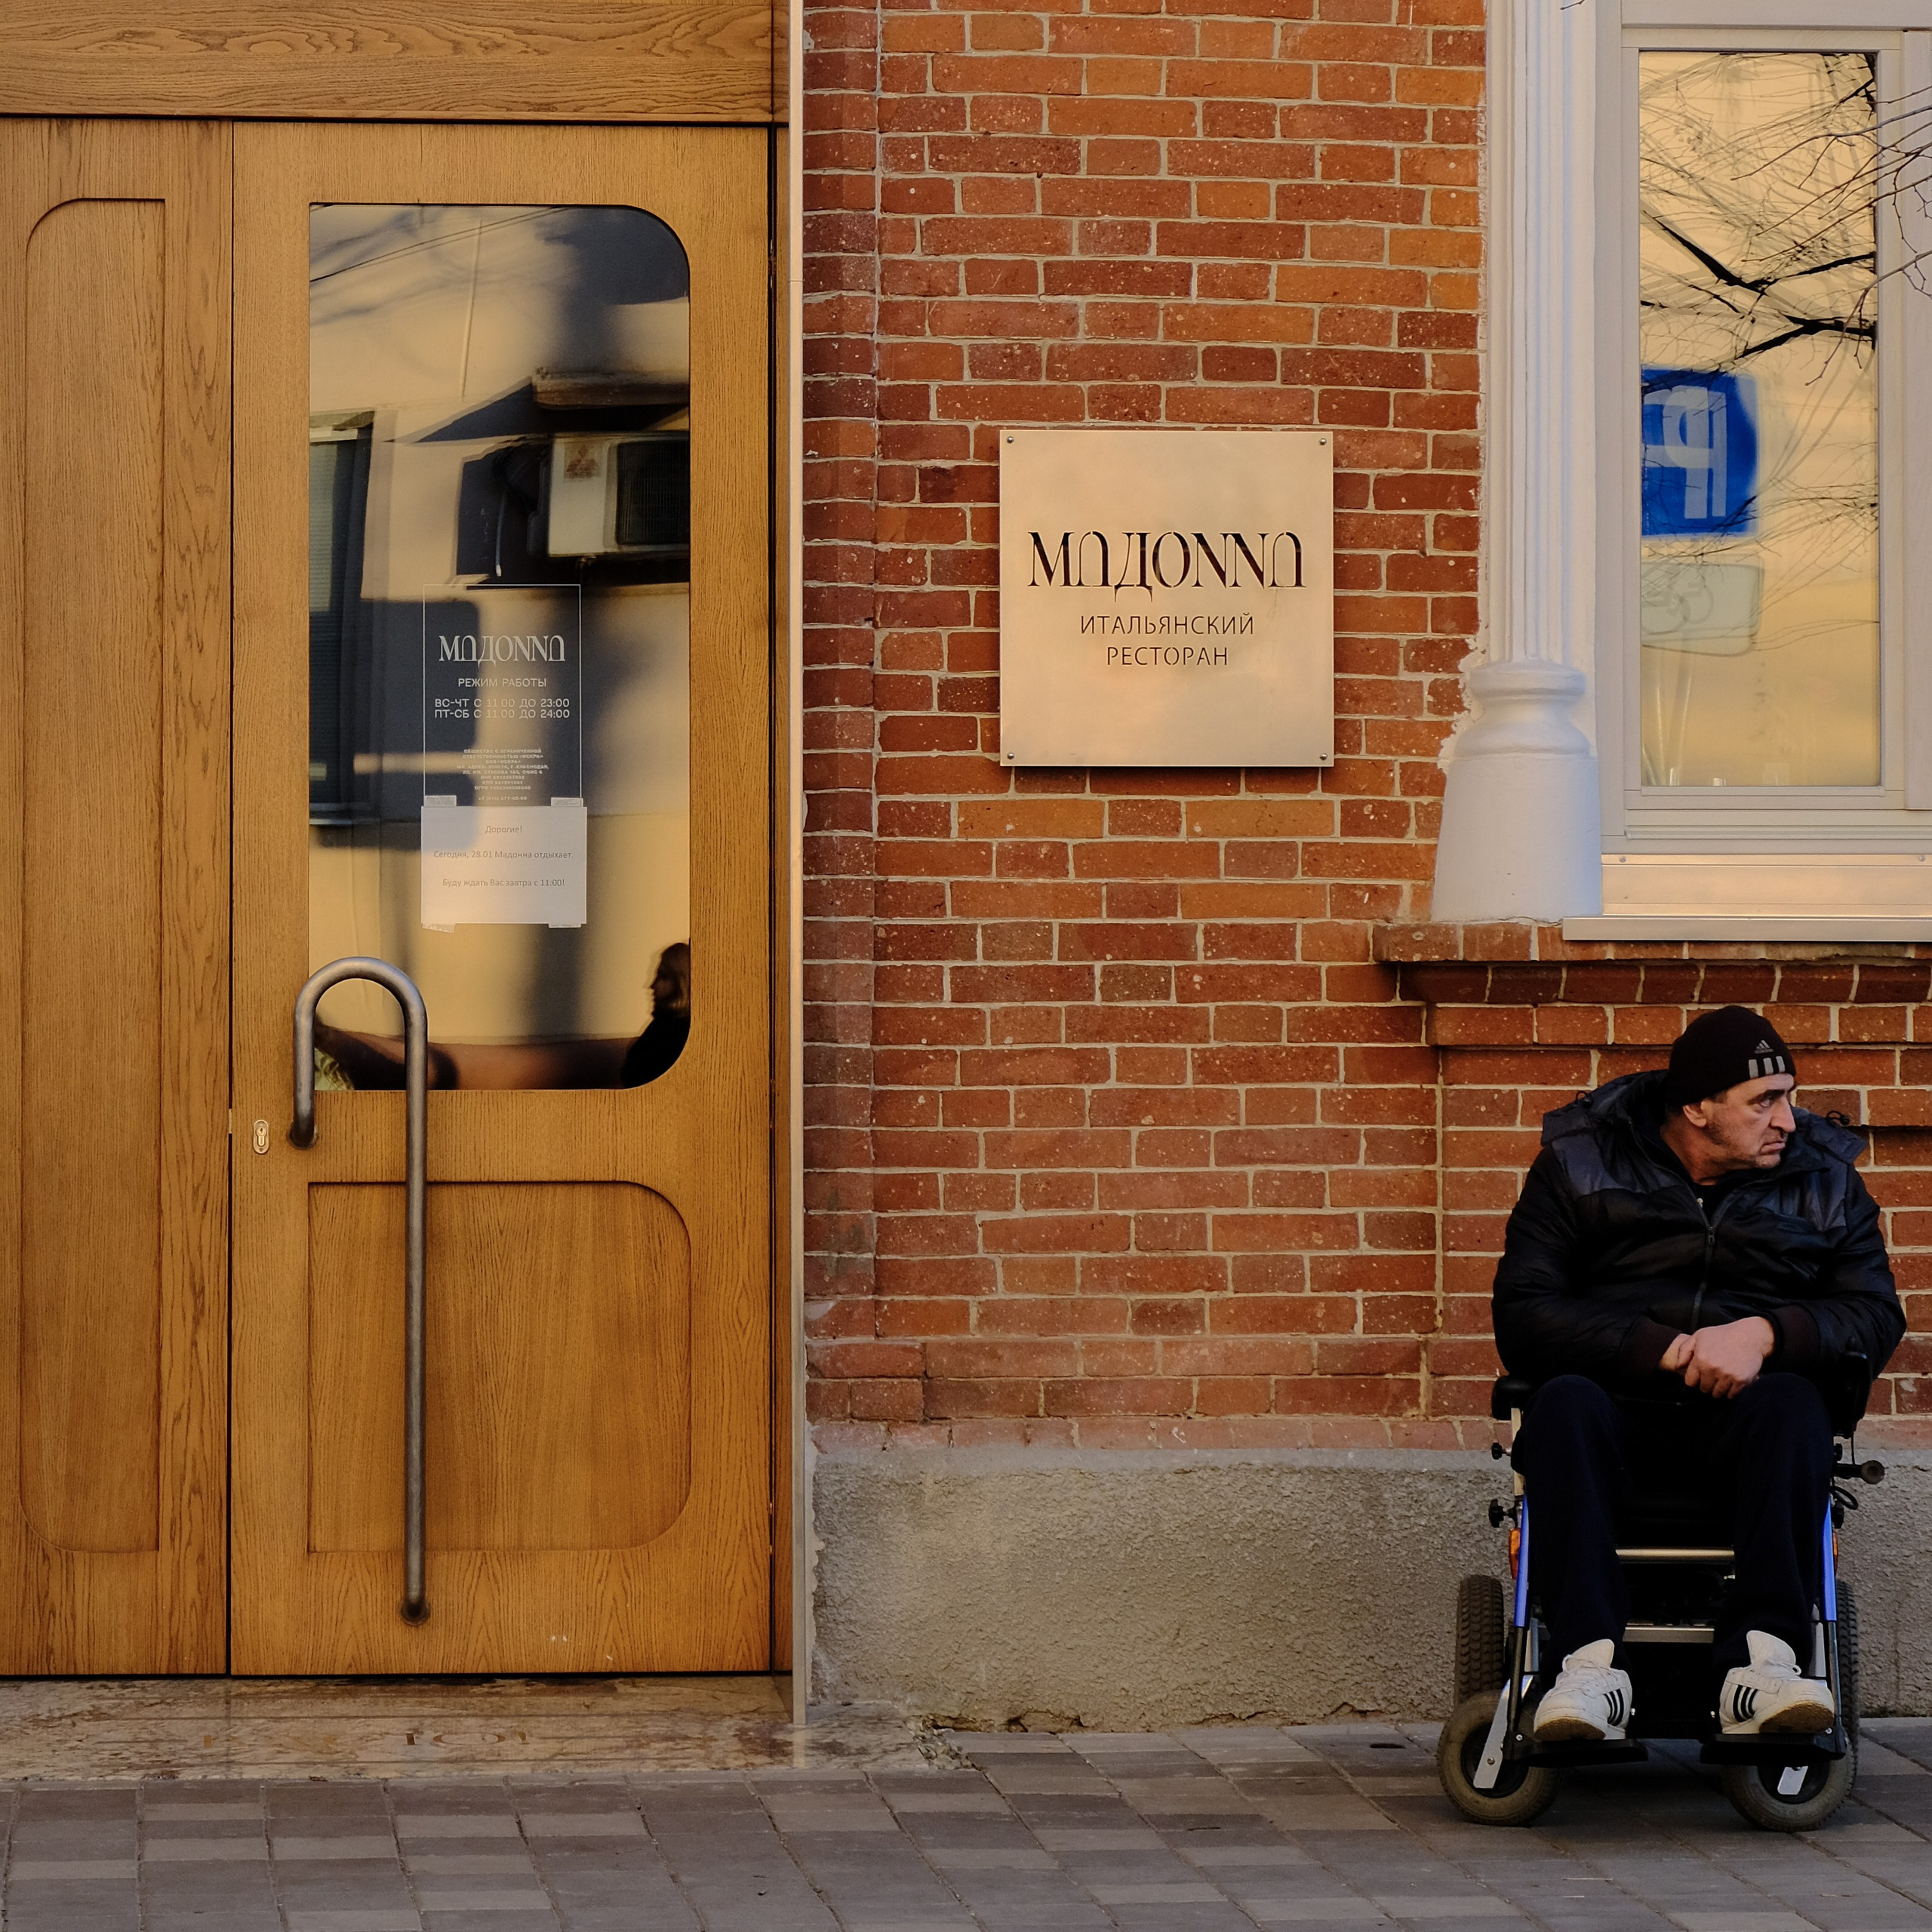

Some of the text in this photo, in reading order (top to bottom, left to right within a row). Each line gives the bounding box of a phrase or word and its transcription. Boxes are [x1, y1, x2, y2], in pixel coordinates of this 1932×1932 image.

[1080, 612, 1254, 635] ИТАЛЬЯНСКИЙ
[1106, 646, 1228, 666] РЕСТОРАН
[458, 678, 546, 687] РЕЖИМ РАБОТЫ
[435, 698, 469, 707] ВС-ЧТ
[473, 698, 482, 707] С
[519, 698, 536, 709] ДО
[540, 698, 570, 707] 23:00
[435, 709, 469, 718] ПТ-СБ
[473, 709, 482, 718] С
[519, 709, 536, 719] ДО
[540, 709, 570, 718] 24:00
[485, 826, 522, 834] Дорогие!
[433, 851, 469, 859] Сегодня,
[494, 851, 532, 859] Мадонна
[442, 879, 462, 888] Буду
